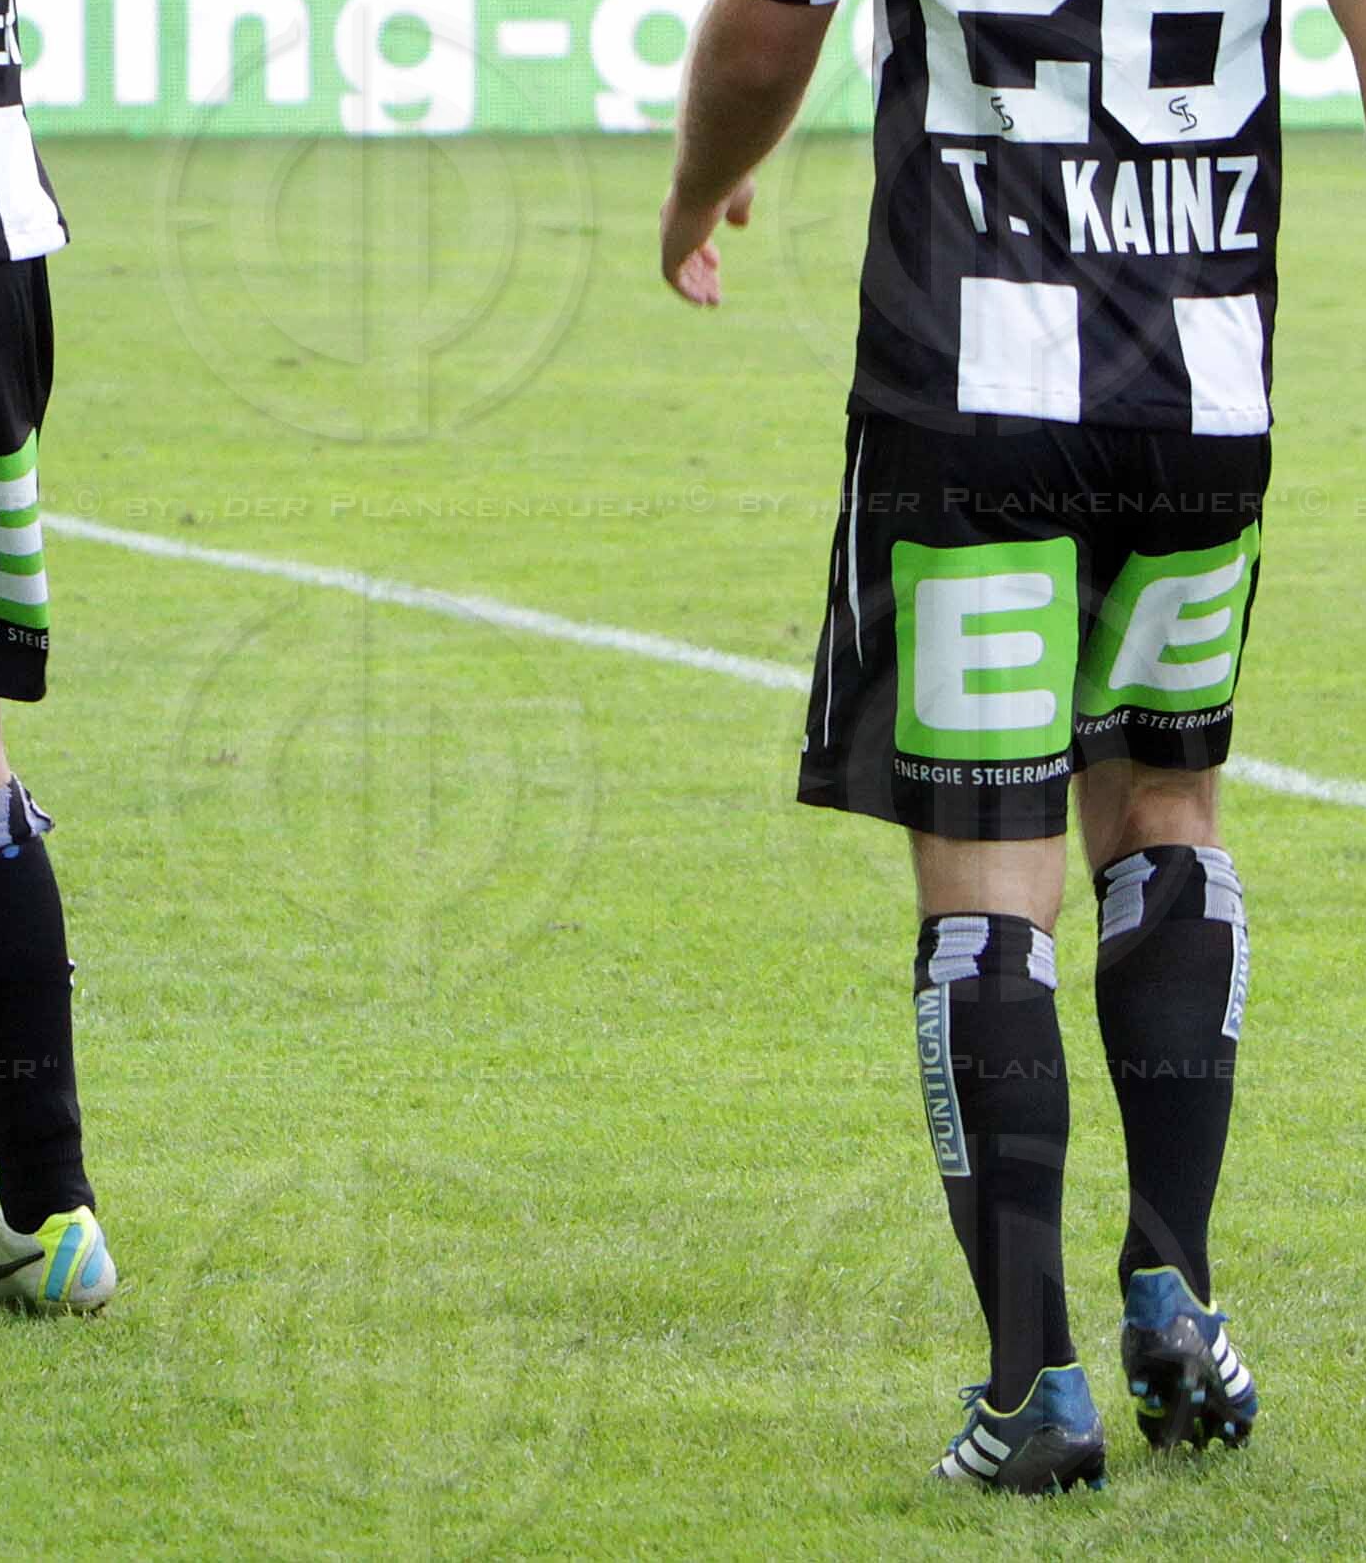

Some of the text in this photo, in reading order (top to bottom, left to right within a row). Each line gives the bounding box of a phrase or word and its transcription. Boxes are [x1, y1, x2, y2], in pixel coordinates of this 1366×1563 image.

[940, 148, 1260, 256] T. KAINZ
[913, 571, 1057, 731] E
[1107, 553, 1246, 690] E
[893, 755, 1070, 786] ENERGIE STEIERMARK
